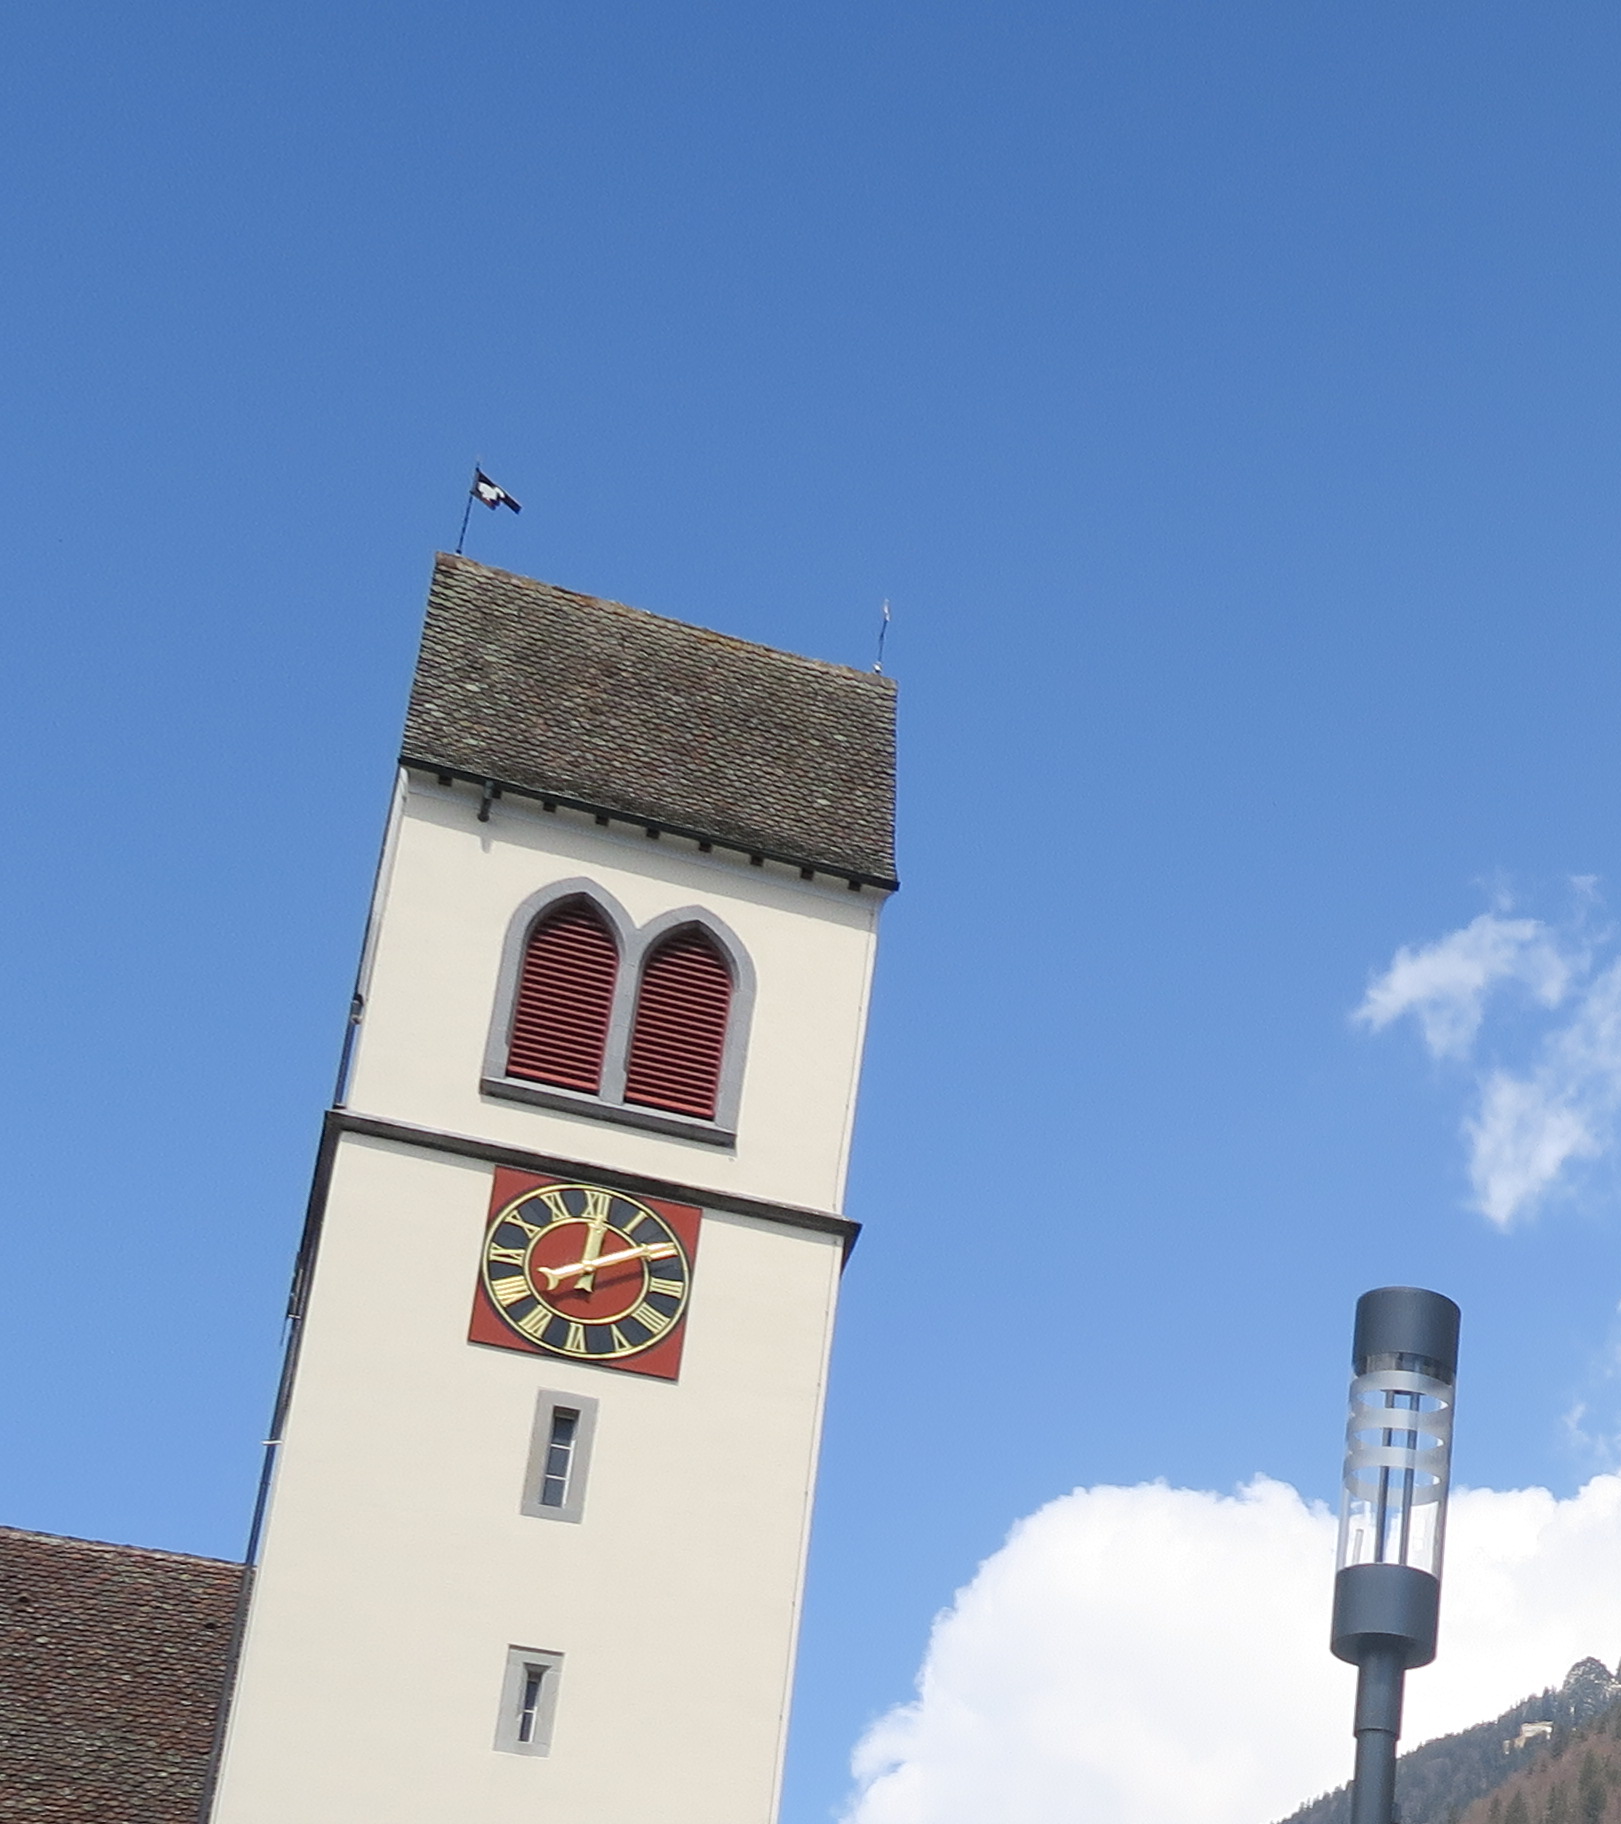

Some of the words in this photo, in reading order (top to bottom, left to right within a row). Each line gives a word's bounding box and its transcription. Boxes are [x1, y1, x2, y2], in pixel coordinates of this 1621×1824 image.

[539, 1191, 571, 1221] XI
[581, 1190, 613, 1222] XII
[504, 1209, 541, 1239] X
[622, 1211, 649, 1235] I
[489, 1242, 525, 1267] IX
[491, 1275, 532, 1308] VIII
[649, 1277, 684, 1299] III
[518, 1303, 553, 1339] VII
[631, 1302, 671, 1334] IIII
[563, 1322, 588, 1353] VI
[610, 1323, 633, 1352] V
